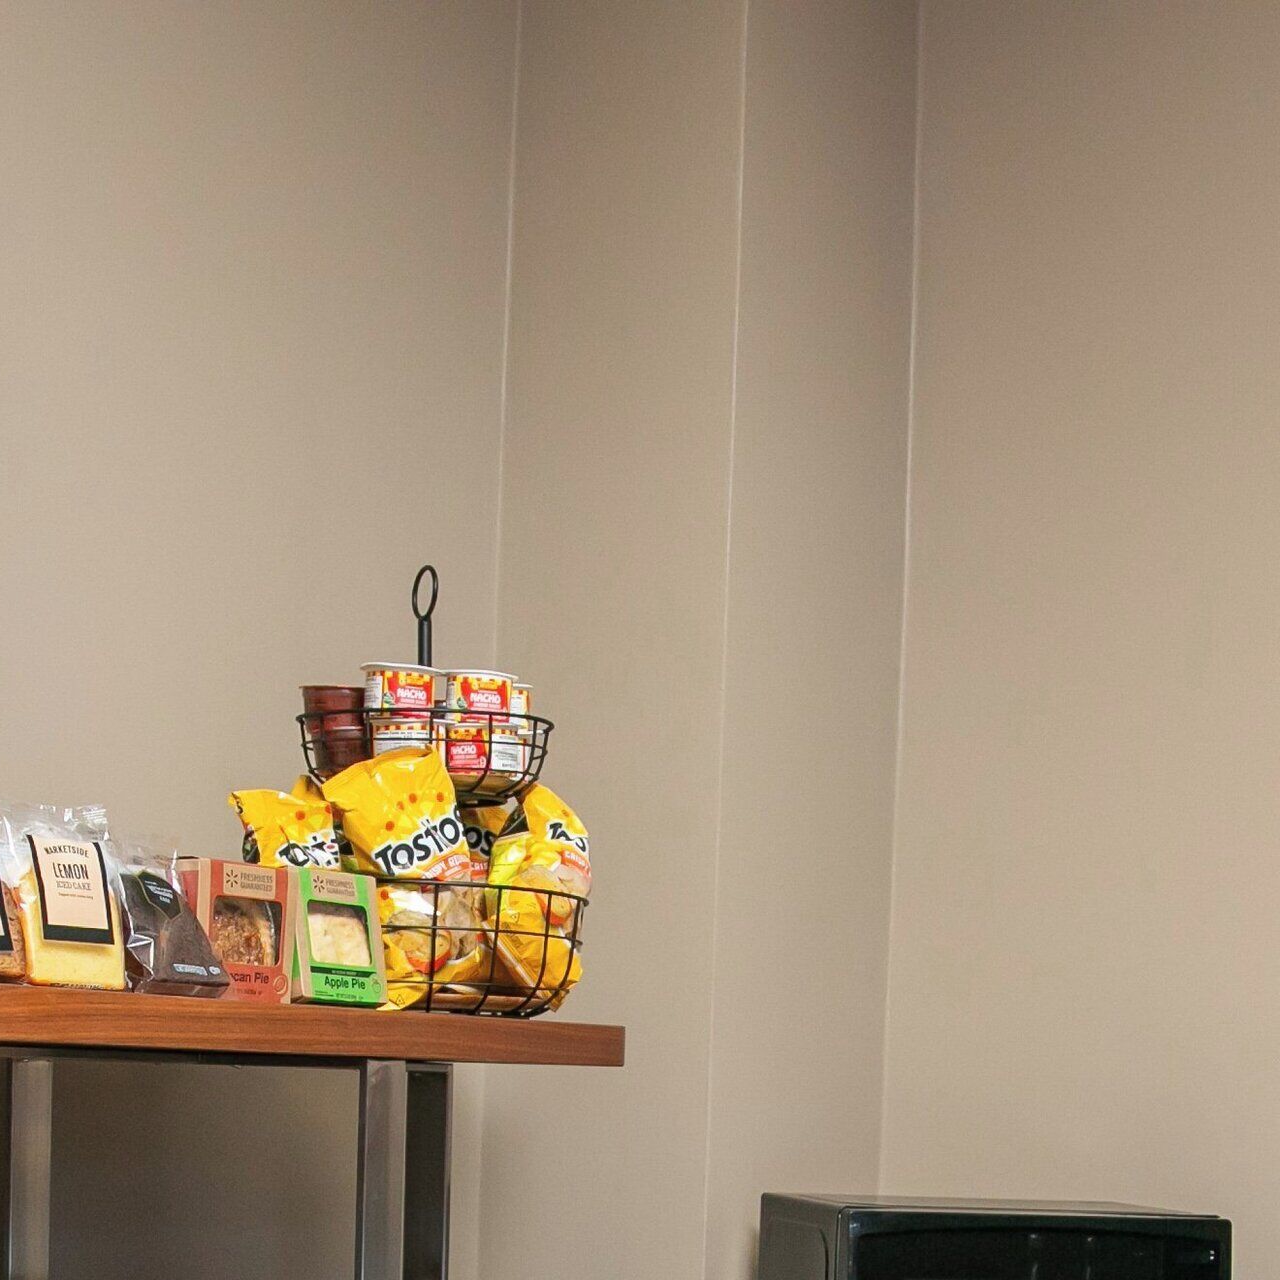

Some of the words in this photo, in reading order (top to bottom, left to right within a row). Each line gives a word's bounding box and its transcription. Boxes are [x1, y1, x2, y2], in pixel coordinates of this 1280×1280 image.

[397, 688, 427, 700] NACHO
[470, 692, 502, 704] NACHO
[44, 845, 89, 858] MARKETSIDE
[52, 862, 89, 880] LEMON
[254, 972, 270, 984] Pie
[324, 976, 350, 989] Apple
[351, 978, 366, 990] Pie
